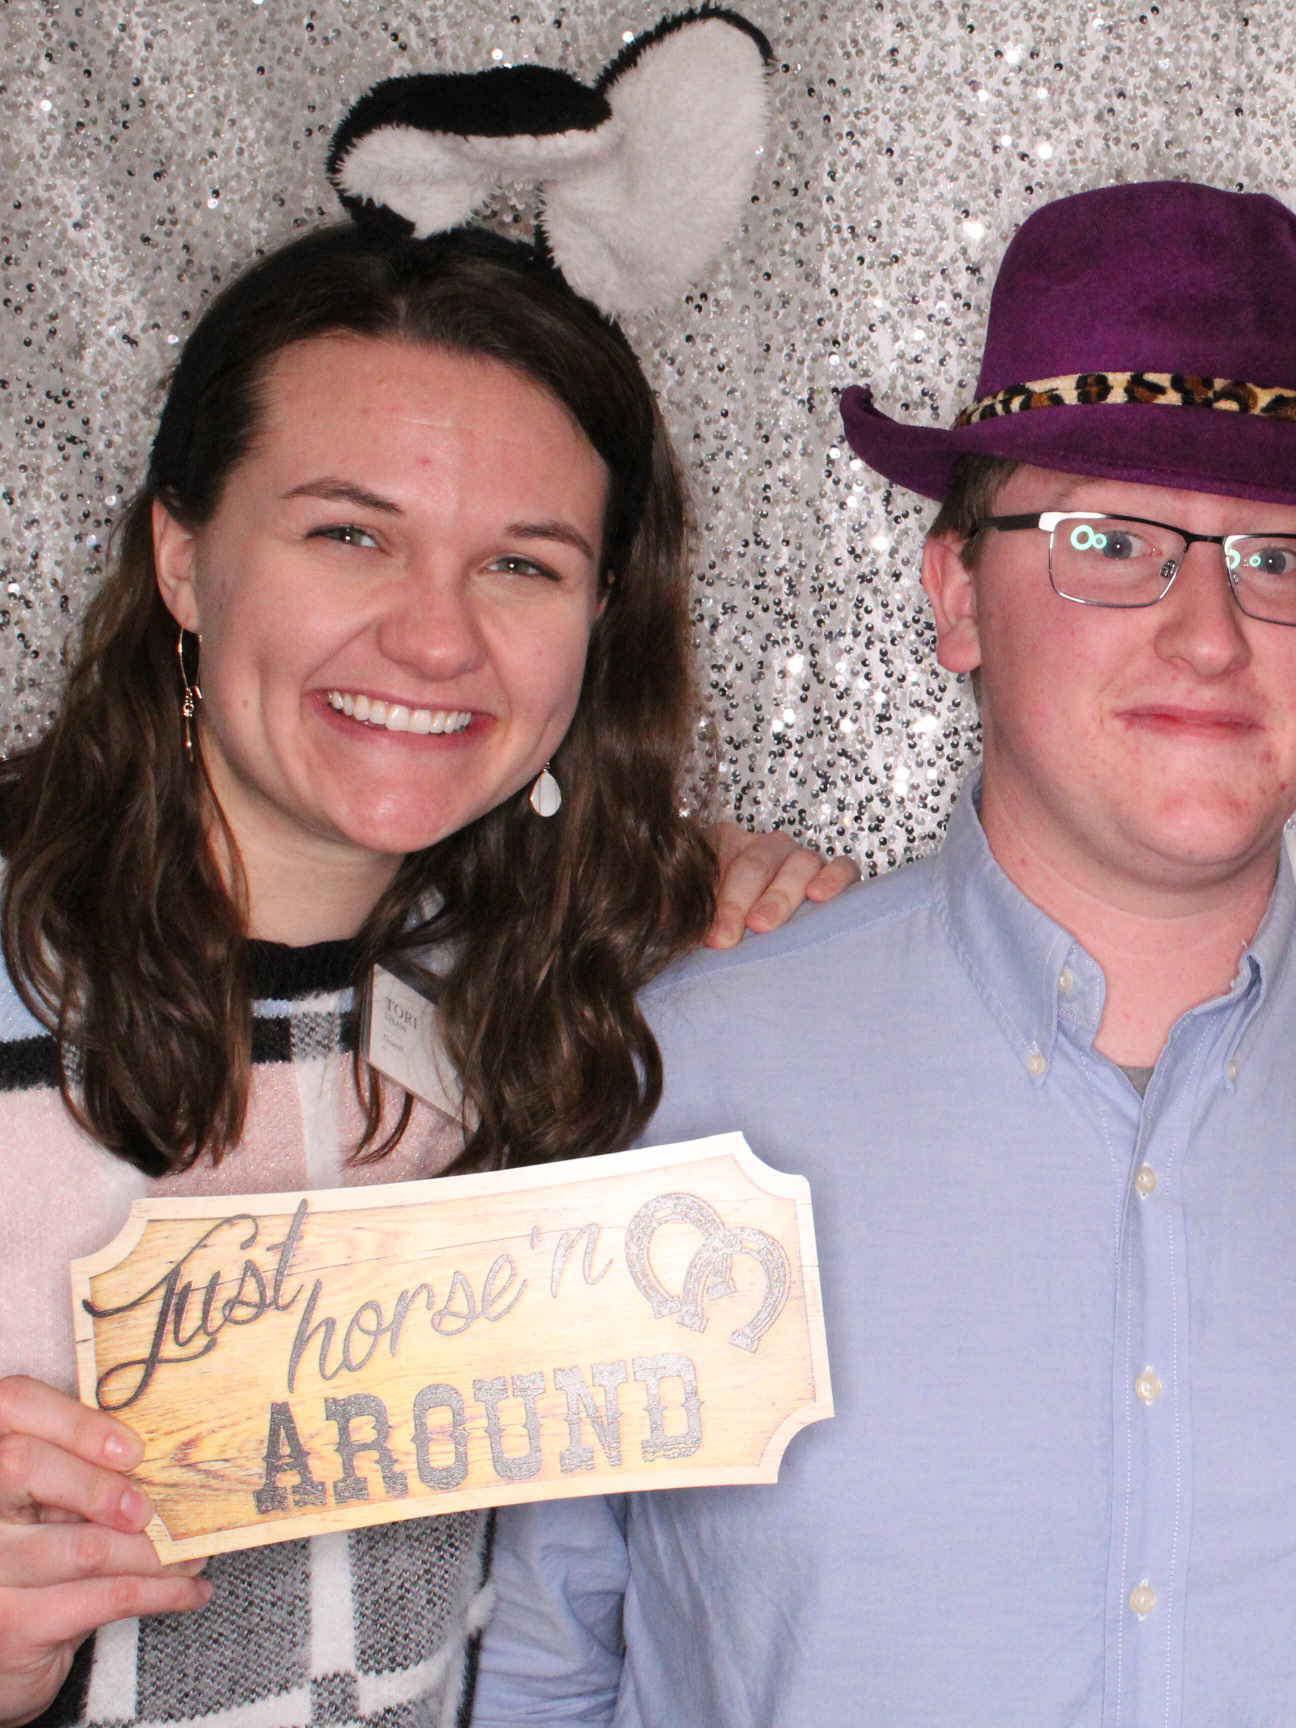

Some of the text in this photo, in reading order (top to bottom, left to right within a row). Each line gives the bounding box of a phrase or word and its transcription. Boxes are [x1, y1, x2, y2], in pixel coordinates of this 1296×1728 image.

[385, 996, 418, 1030] TORI
[83, 1198, 307, 1412] Just
[253, 1352, 704, 1515] AROUND
